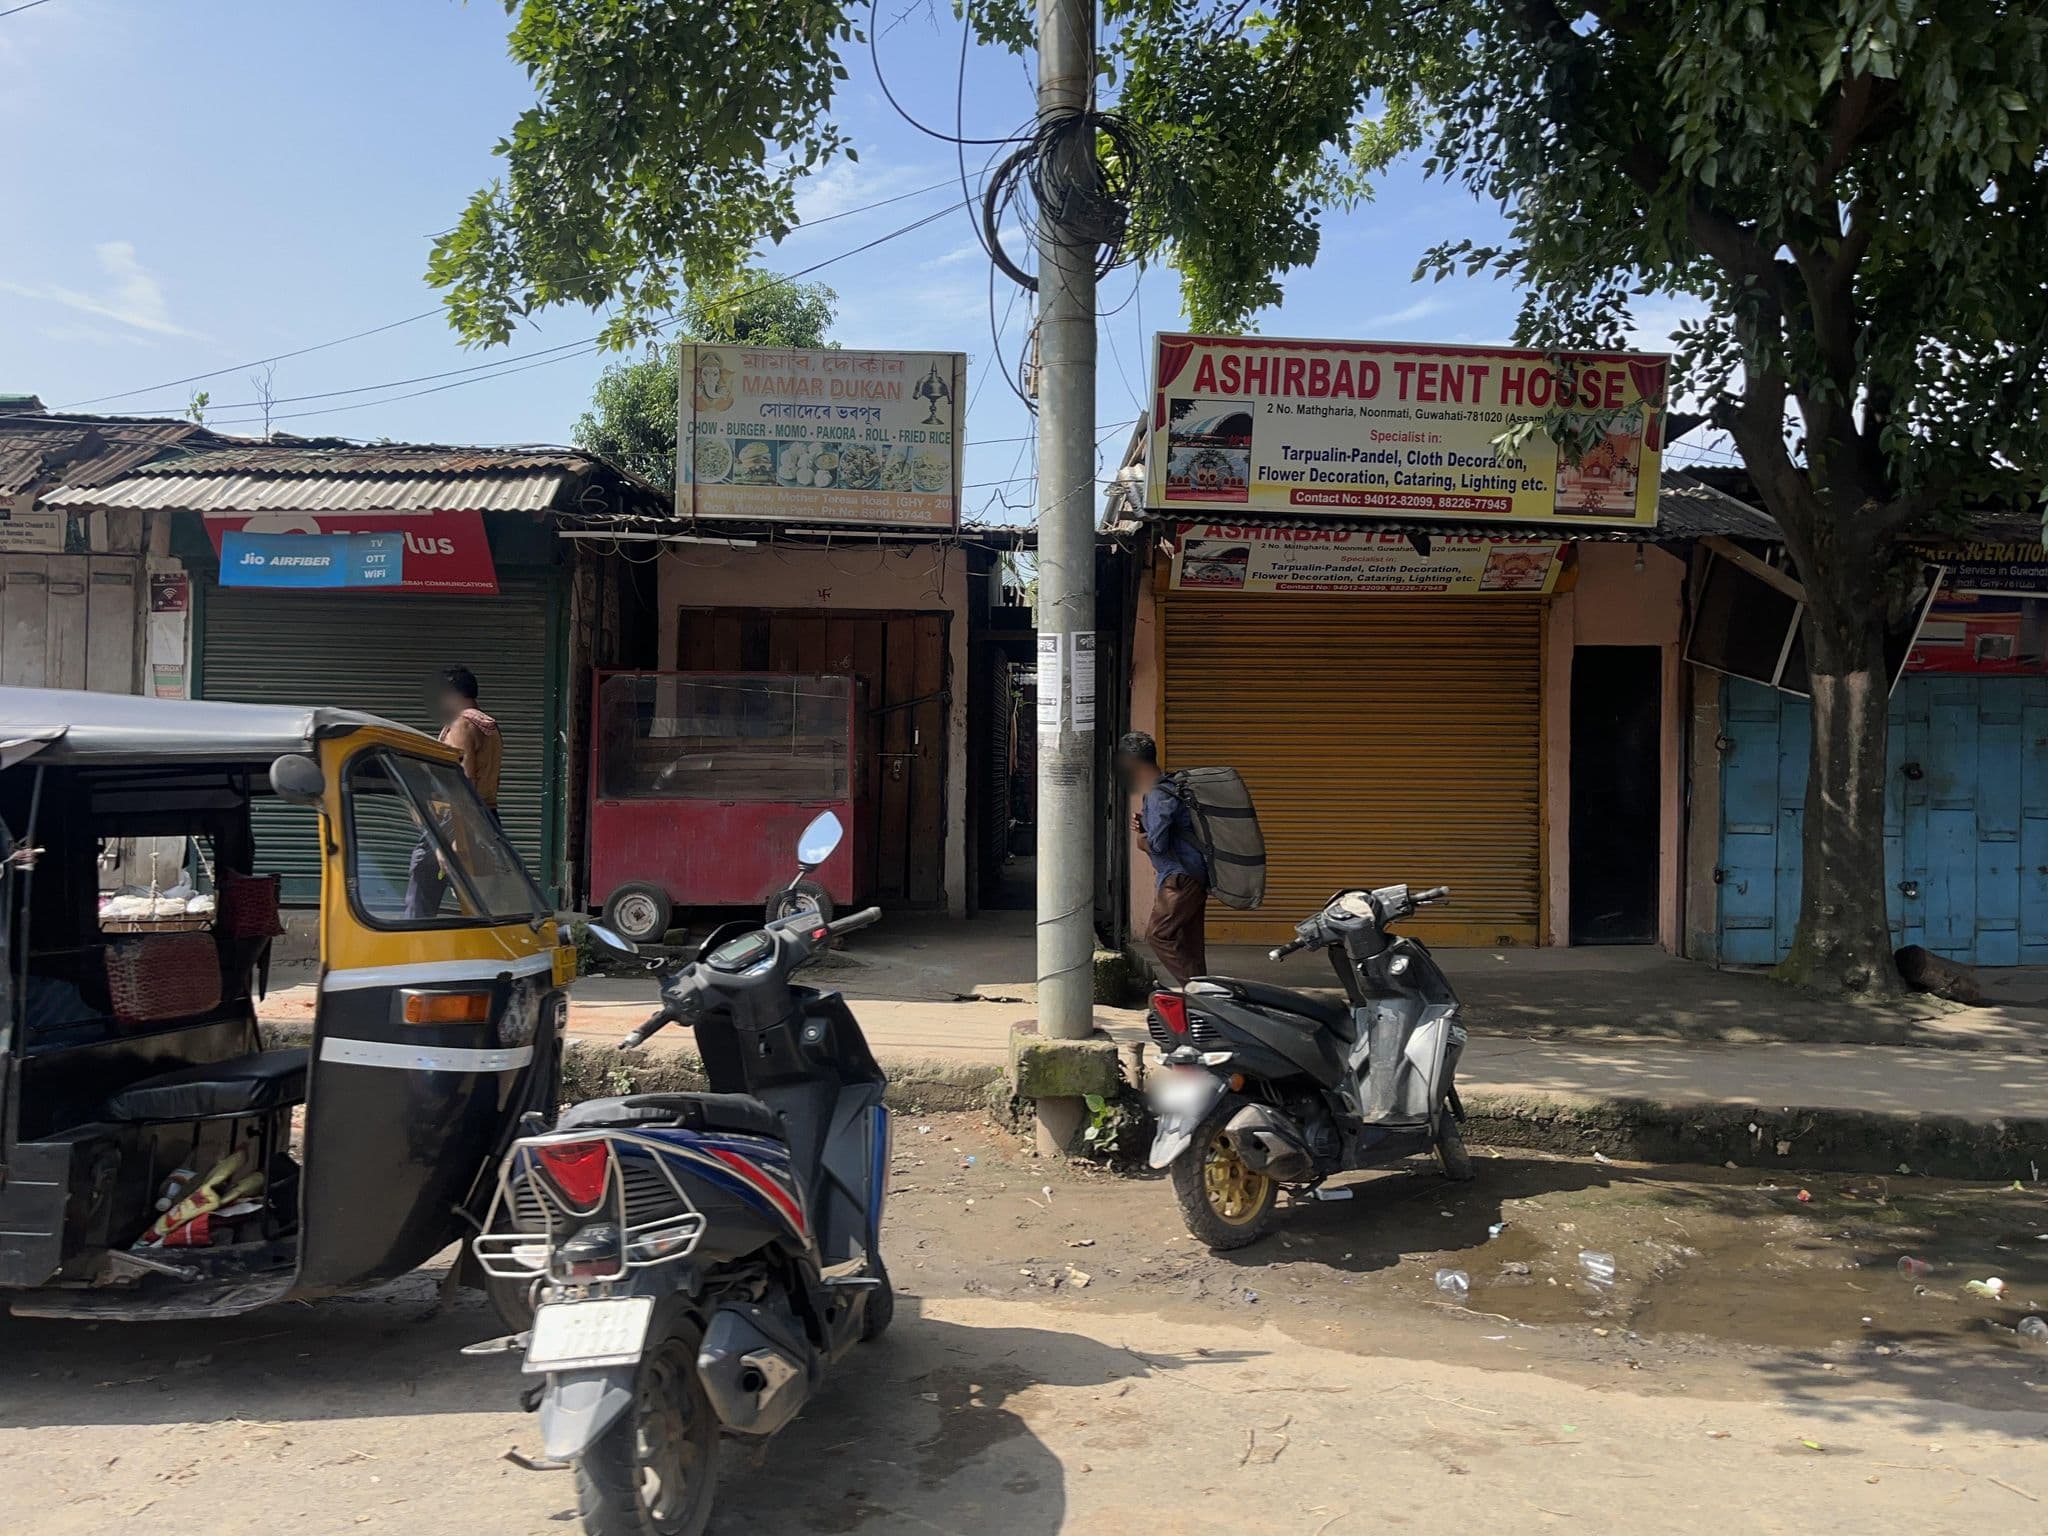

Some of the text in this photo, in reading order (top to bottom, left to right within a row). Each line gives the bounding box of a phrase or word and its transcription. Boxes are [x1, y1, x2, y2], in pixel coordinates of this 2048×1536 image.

[822, 354, 904, 373] দোকান
[742, 375, 903, 400] MAMAR DUKAN
[1193, 354, 1626, 410] ASHIRBAD TENT HOUSE
[1266, 402, 1274, 414] 2
[1276, 403, 1294, 415] No.
[1297, 404, 1357, 418] Mathgharia,
[1360, 408, 1412, 420] Noonmati,
[1415, 408, 1502, 423] Guwahati-781020
[687, 421, 951, 444] CHOW BURGER MOMO PAKORA ROLL FRIED RICE
[1370, 429, 1442, 443] Specialist in:
[1281, 445, 1527, 472] Tarpualin-Pandel, Cloth Decoraon,
[1258, 466, 1548, 494] Flower Decoration, Cataring, Lighting etc.
[1296, 491, 1507, 510] Contact No: 94012-82099, 88226-77945
[402, 531, 455, 555] lus
[240, 552, 331, 566] Jio AIRFIBER
[366, 555, 386, 563] OTT
[1271, 562, 1461, 574] Tarpualin-Pandel, Cloth Decoration,
[1252, 571, 1288, 580] Flower
[1292, 572, 1353, 583] Decoration,
[1357, 574, 1405, 584] Cataring,
[1409, 575, 1454, 584] Lighting
